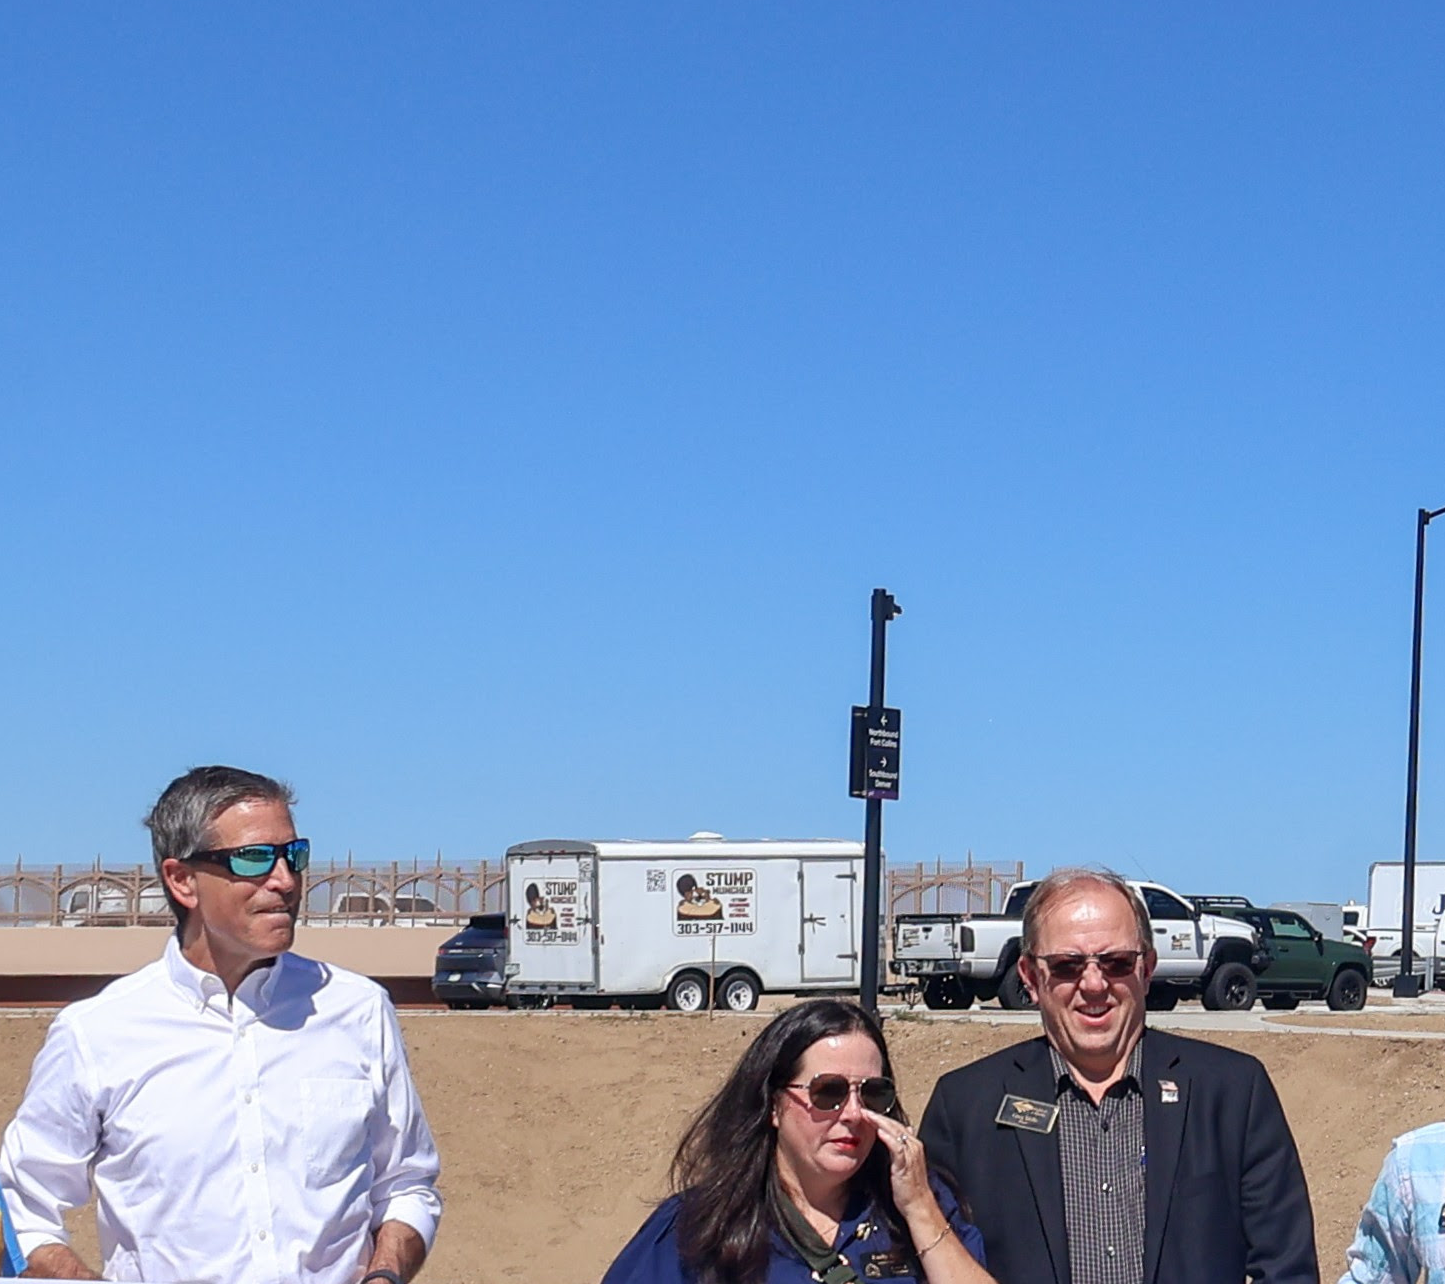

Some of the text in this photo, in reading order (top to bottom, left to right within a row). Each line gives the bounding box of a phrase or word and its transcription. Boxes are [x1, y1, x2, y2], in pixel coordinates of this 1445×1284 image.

[705, 872, 753, 886] STUMP
[545, 881, 577, 896] STUMP
[712, 886, 753, 895] MUNCHER
[677, 922, 753, 935] 303-517-1144
